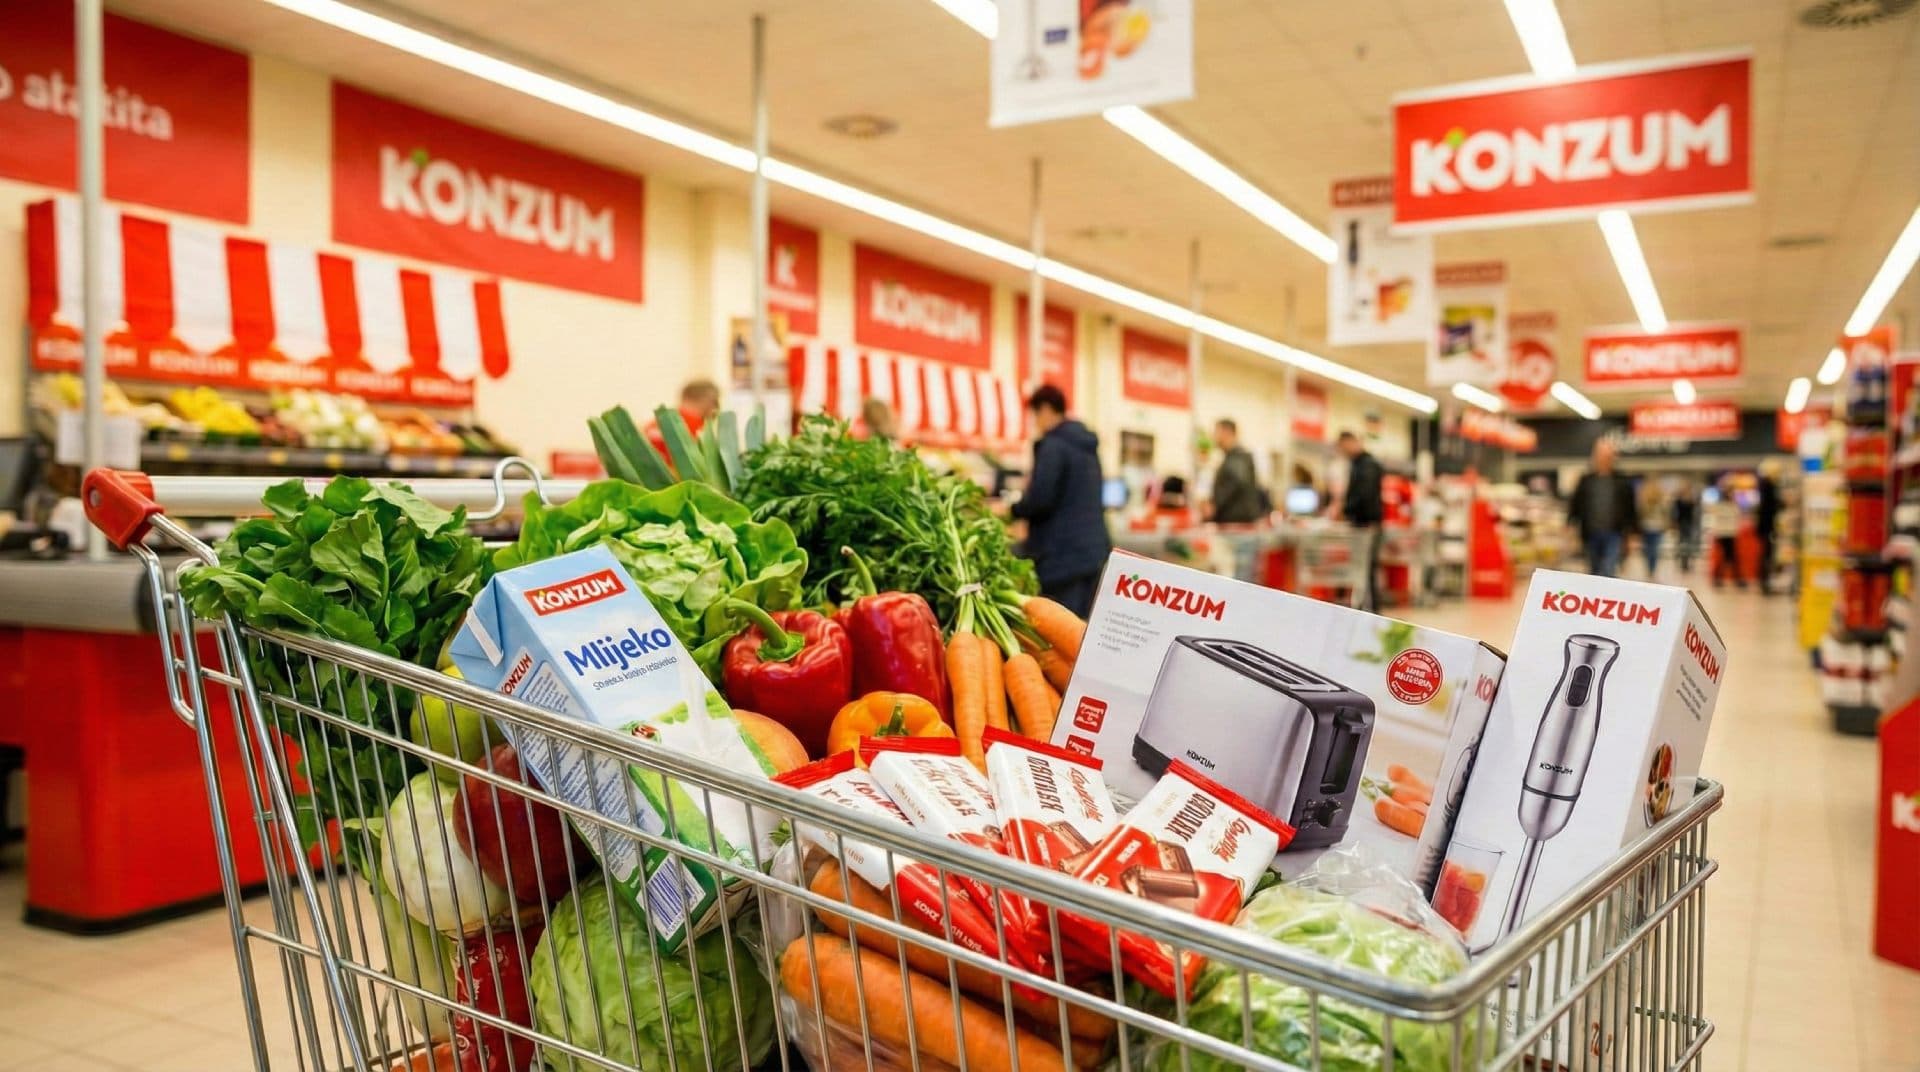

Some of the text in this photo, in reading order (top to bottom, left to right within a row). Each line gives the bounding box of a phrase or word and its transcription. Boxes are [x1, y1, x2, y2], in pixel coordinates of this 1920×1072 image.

[23, 69, 174, 140] ataita
[1411, 104, 1732, 197] KONZUM
[380, 147, 615, 261] KONZUM
[871, 279, 981, 345] KONZUM
[1591, 341, 1736, 374] KONZUM
[533, 576, 617, 611] KONZUM
[1115, 574, 1226, 621] KONZUM
[1541, 591, 1661, 626] KONZUM
[501, 653, 533, 695] ONZUM
[564, 627, 672, 677] Mlijeko
[1684, 621, 1720, 685] KONZUM
